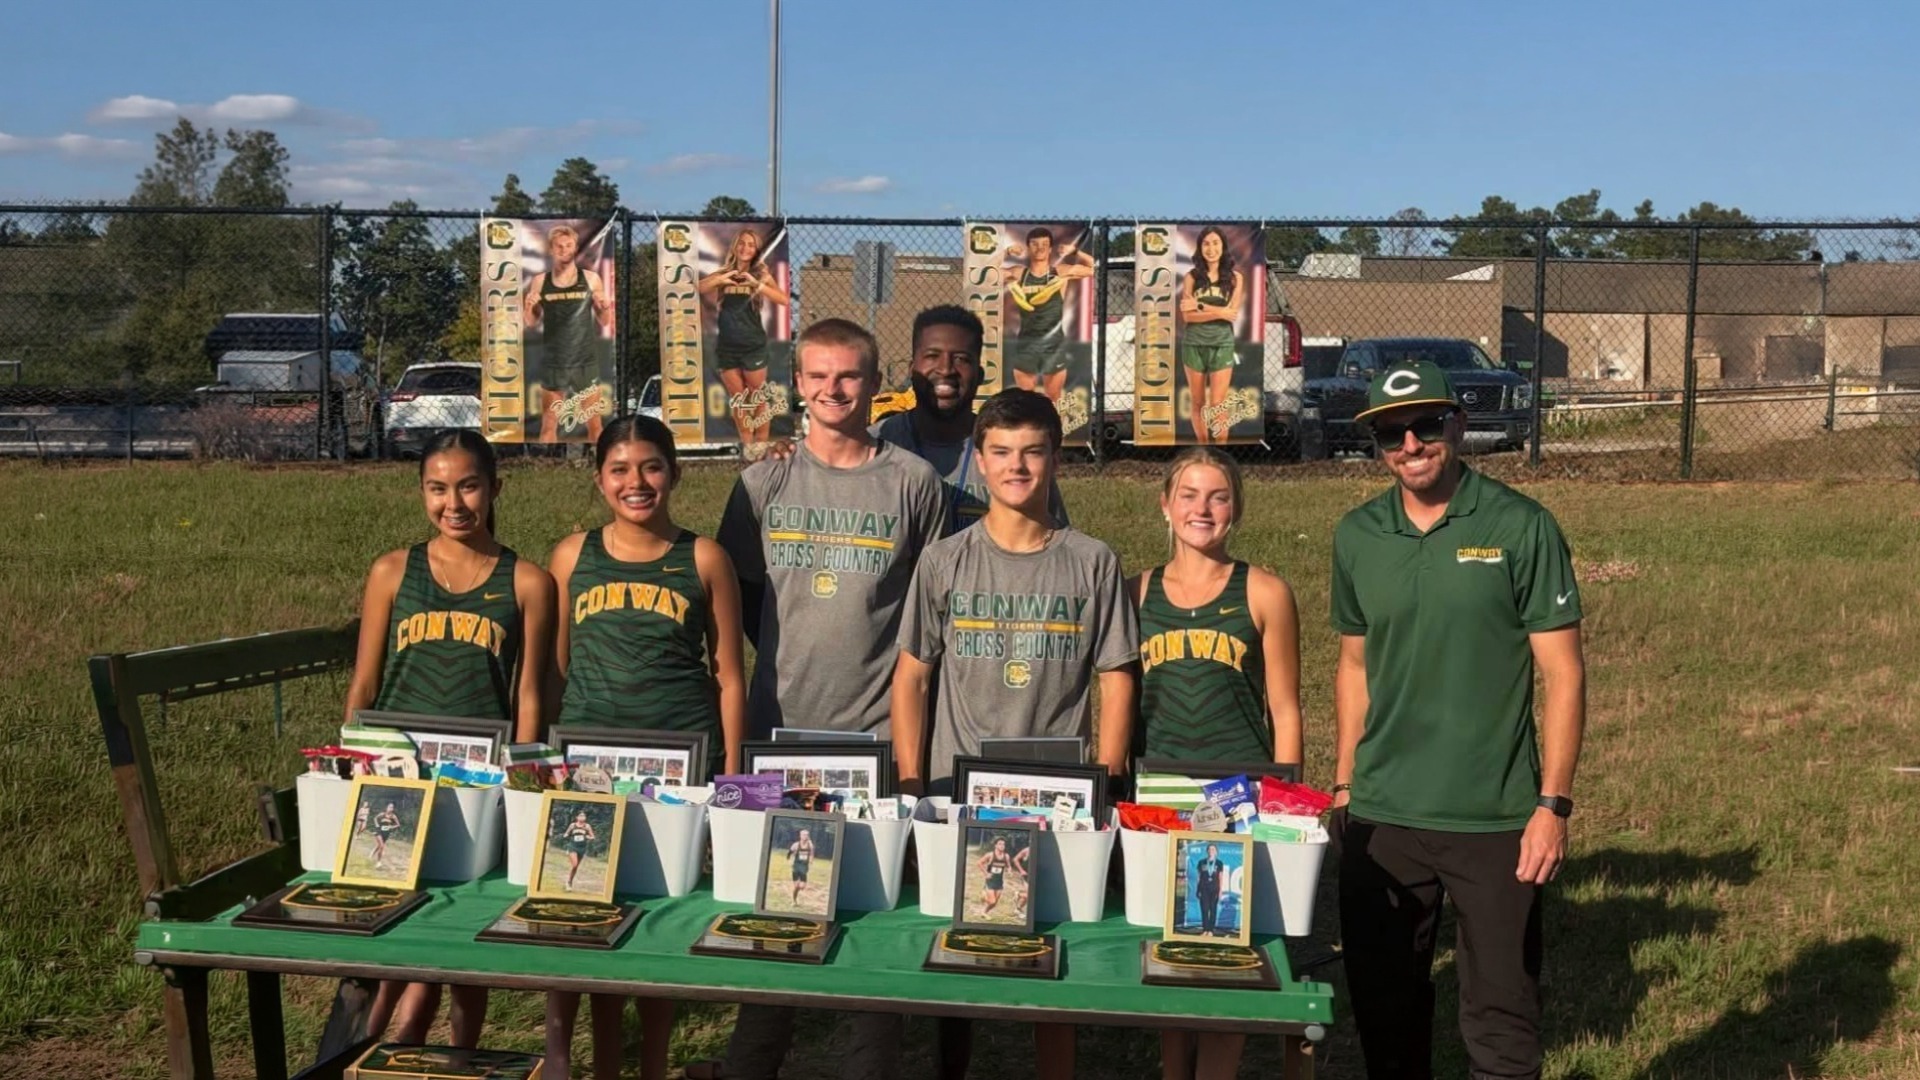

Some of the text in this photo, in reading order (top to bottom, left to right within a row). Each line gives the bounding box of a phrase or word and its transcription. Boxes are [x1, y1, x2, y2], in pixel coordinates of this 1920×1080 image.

[486, 260, 520, 434] TIGERS
[664, 263, 700, 436] TIGERS
[1140, 265, 1172, 437] TIGERS
[1382, 369, 1421, 397] C
[766, 504, 900, 539] CONWAY
[808, 534, 852, 544] TIGERS
[770, 542, 894, 577] CROSS COUNTRY
[1457, 547, 1503, 558] CONWAY
[575, 582, 691, 626] CONWAY
[951, 591, 1091, 621] CONWAY
[397, 610, 507, 657] CONWAY
[997, 622, 1044, 631] TIGERS
[955, 630, 1082, 661] CROSS COUNTRY
[1140, 628, 1247, 674] CONWAY
[717, 790, 741, 804] nice
